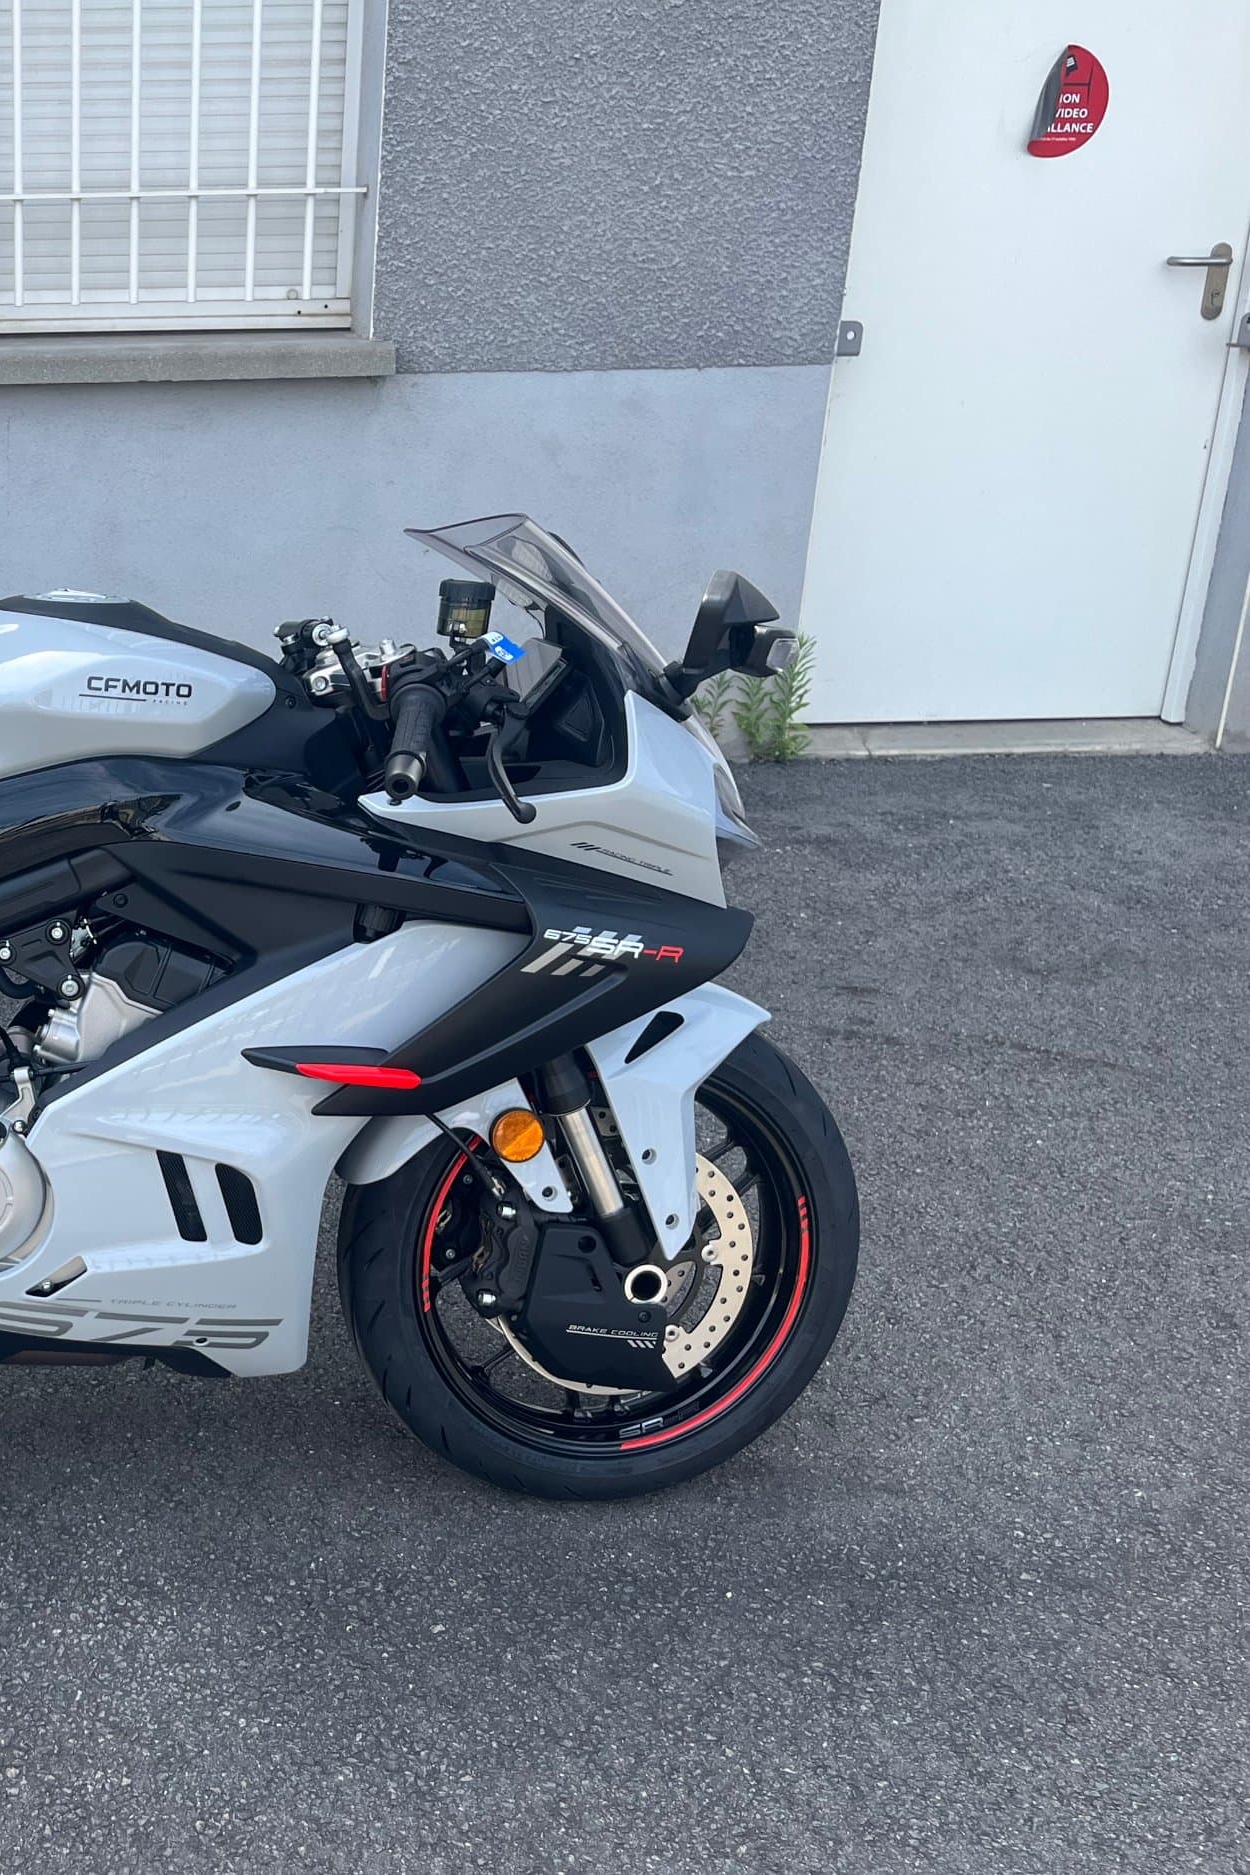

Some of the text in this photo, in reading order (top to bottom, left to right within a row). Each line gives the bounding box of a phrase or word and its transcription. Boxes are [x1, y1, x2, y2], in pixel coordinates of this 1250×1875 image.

[87, 676, 193, 698] CFMOTO
[568, 1324, 659, 1338] BRAKE COOLING
